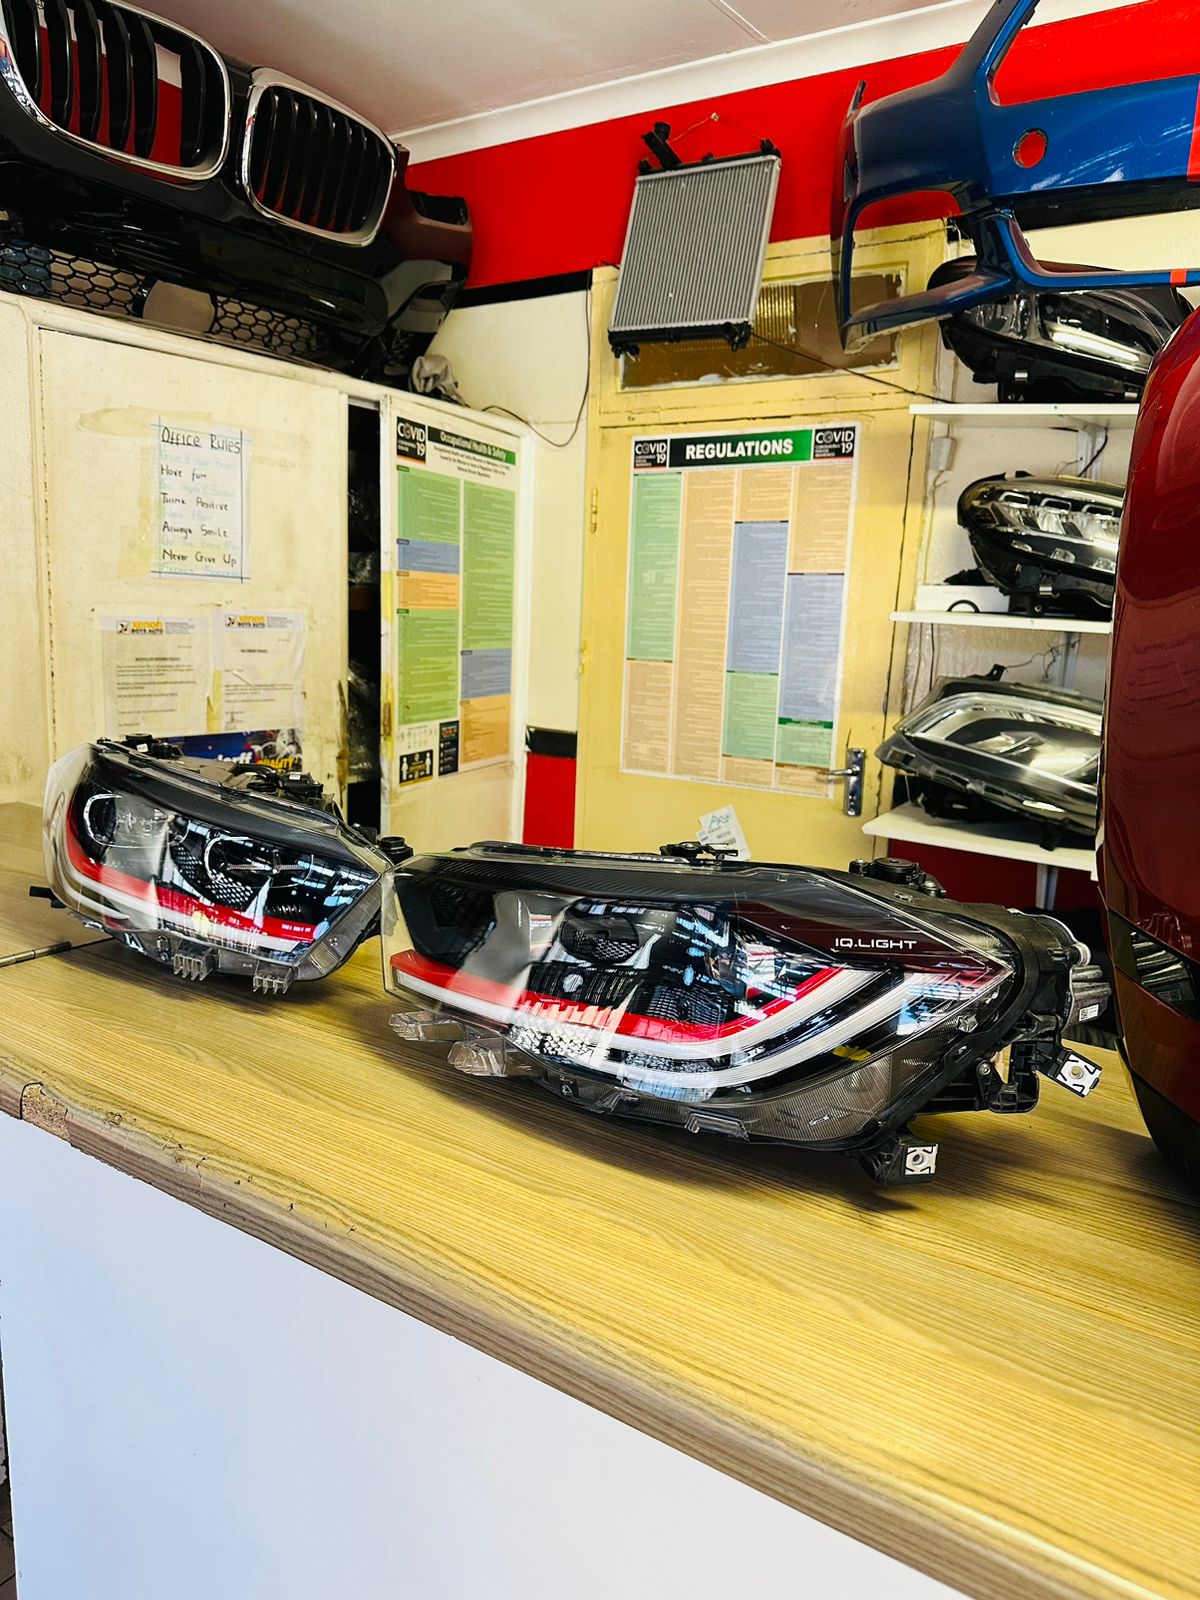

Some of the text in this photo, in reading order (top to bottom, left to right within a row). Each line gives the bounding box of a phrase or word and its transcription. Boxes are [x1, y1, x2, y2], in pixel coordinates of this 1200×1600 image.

[397, 422, 426, 443] COVID
[815, 430, 854, 445] COVID
[210, 434, 240, 454] Rules
[416, 442, 426, 456] 19
[440, 431, 472, 451] Occupational
[493, 447, 506, 462] Safety
[634, 441, 667, 455] COVID
[685, 438, 794, 460] REGULATIONS
[840, 442, 854, 454] 19
[656, 453, 667, 464] 19
[160, 464, 207, 482] Have fun
[196, 496, 229, 511] Positive
[162, 521, 228, 539] Always Smile
[162, 549, 237, 567] Never Give Up
[835, 937, 917, 950] IQ.LIGHT
